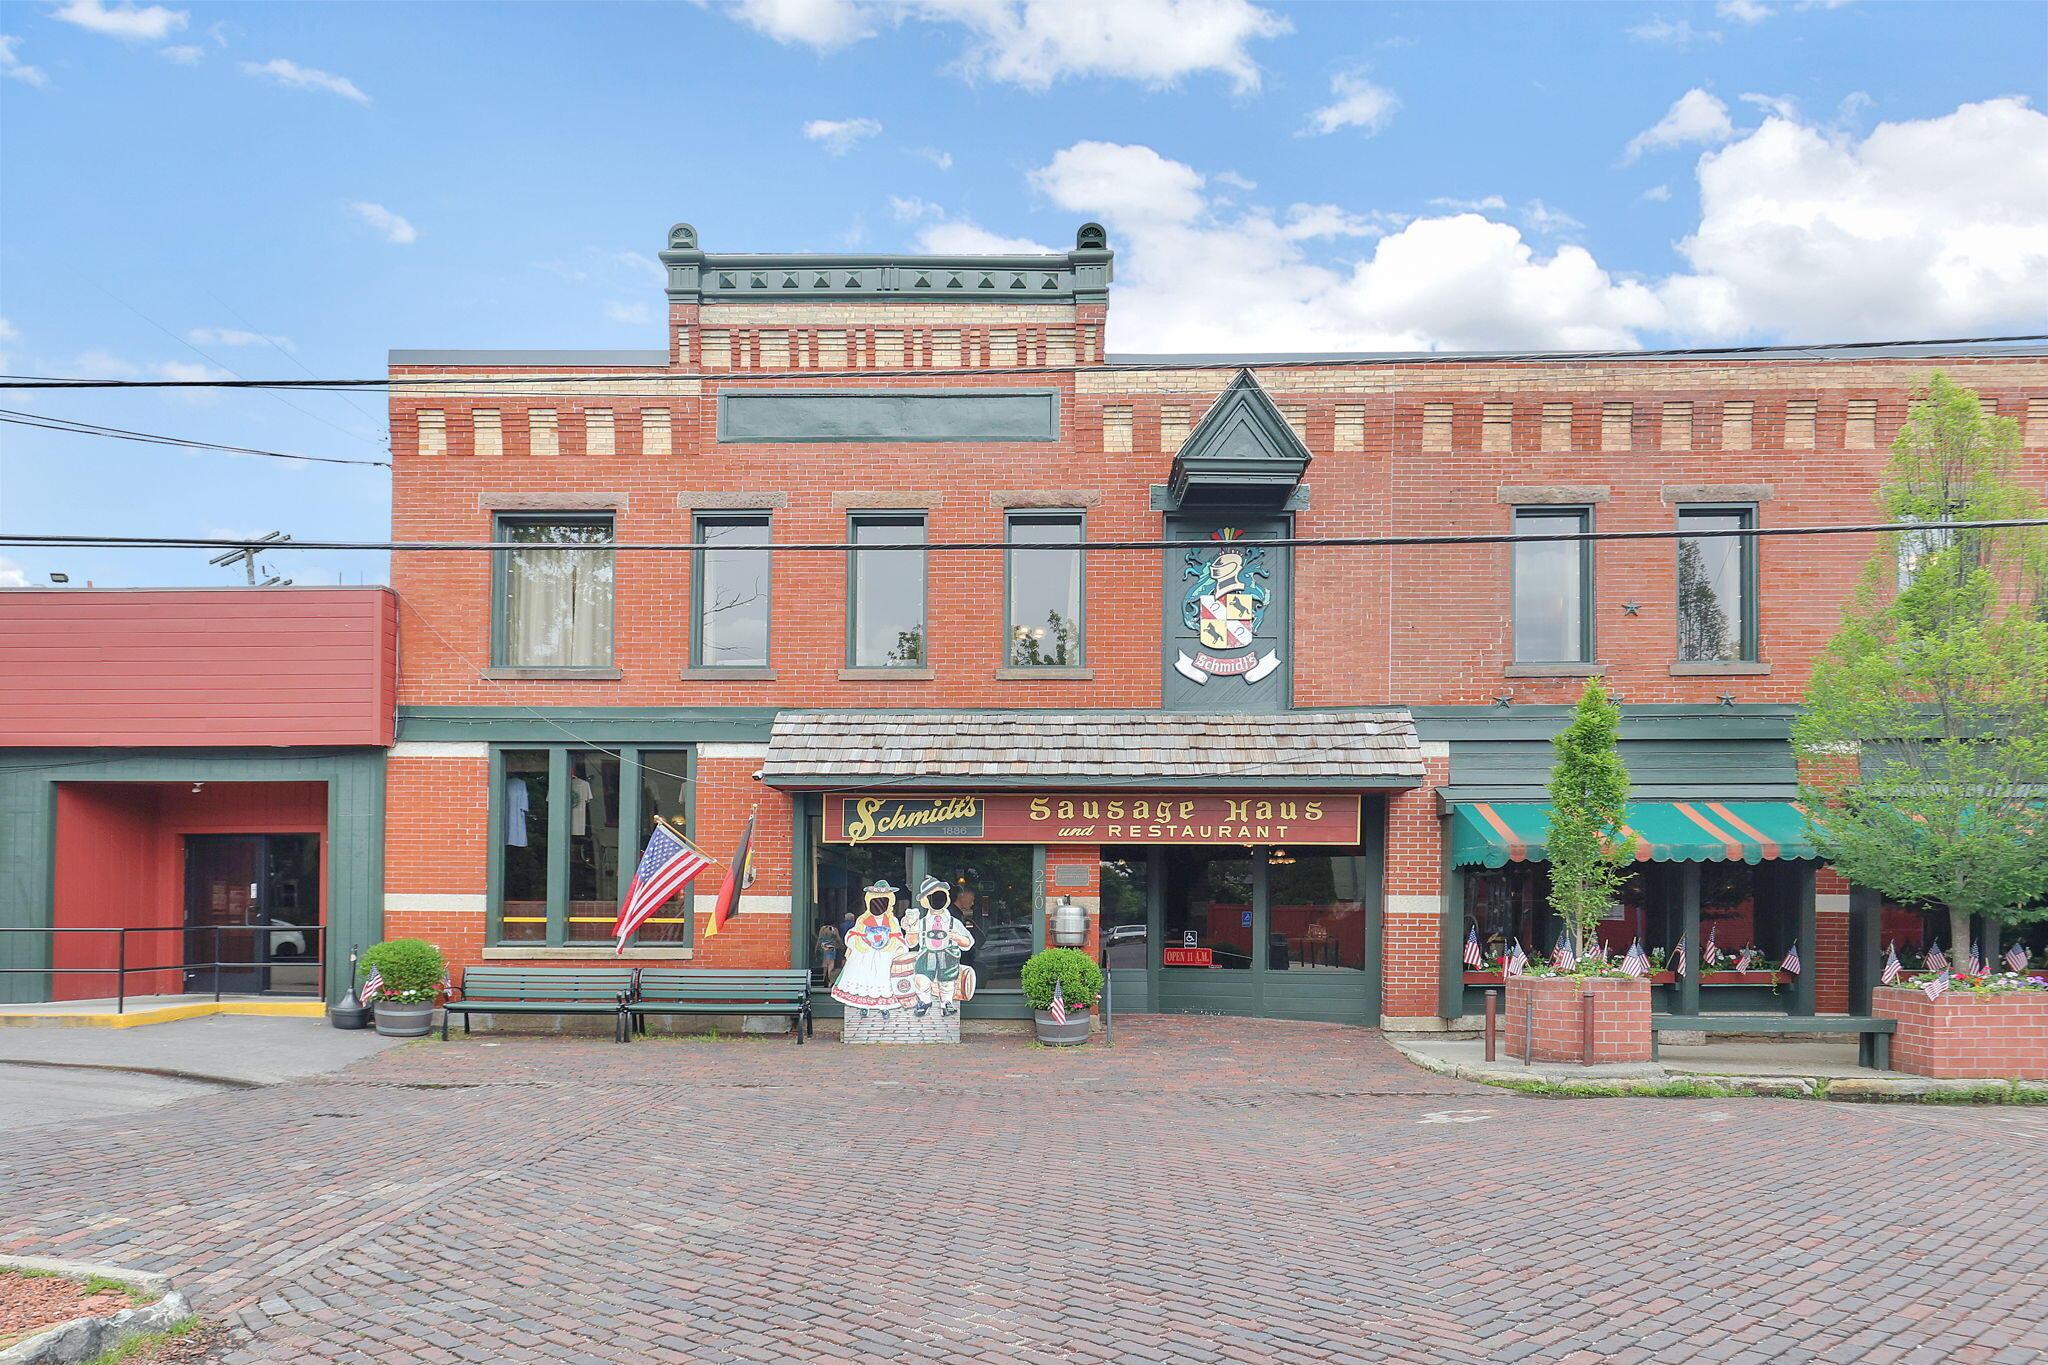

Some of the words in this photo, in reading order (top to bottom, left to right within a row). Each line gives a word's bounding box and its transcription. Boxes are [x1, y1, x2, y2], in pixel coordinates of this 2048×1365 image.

[848, 795, 977, 846] Schmidt's
[1029, 797, 1196, 824] Sausage
[1224, 799, 1324, 823] Haus
[942, 826, 967, 835] 1886
[1057, 824, 1096, 837] und
[1108, 825, 1288, 838] RESTAURANT
[1034, 869, 1044, 910] 240
[1166, 951, 1185, 962] OPEN
[1187, 952, 1193, 962] 11
